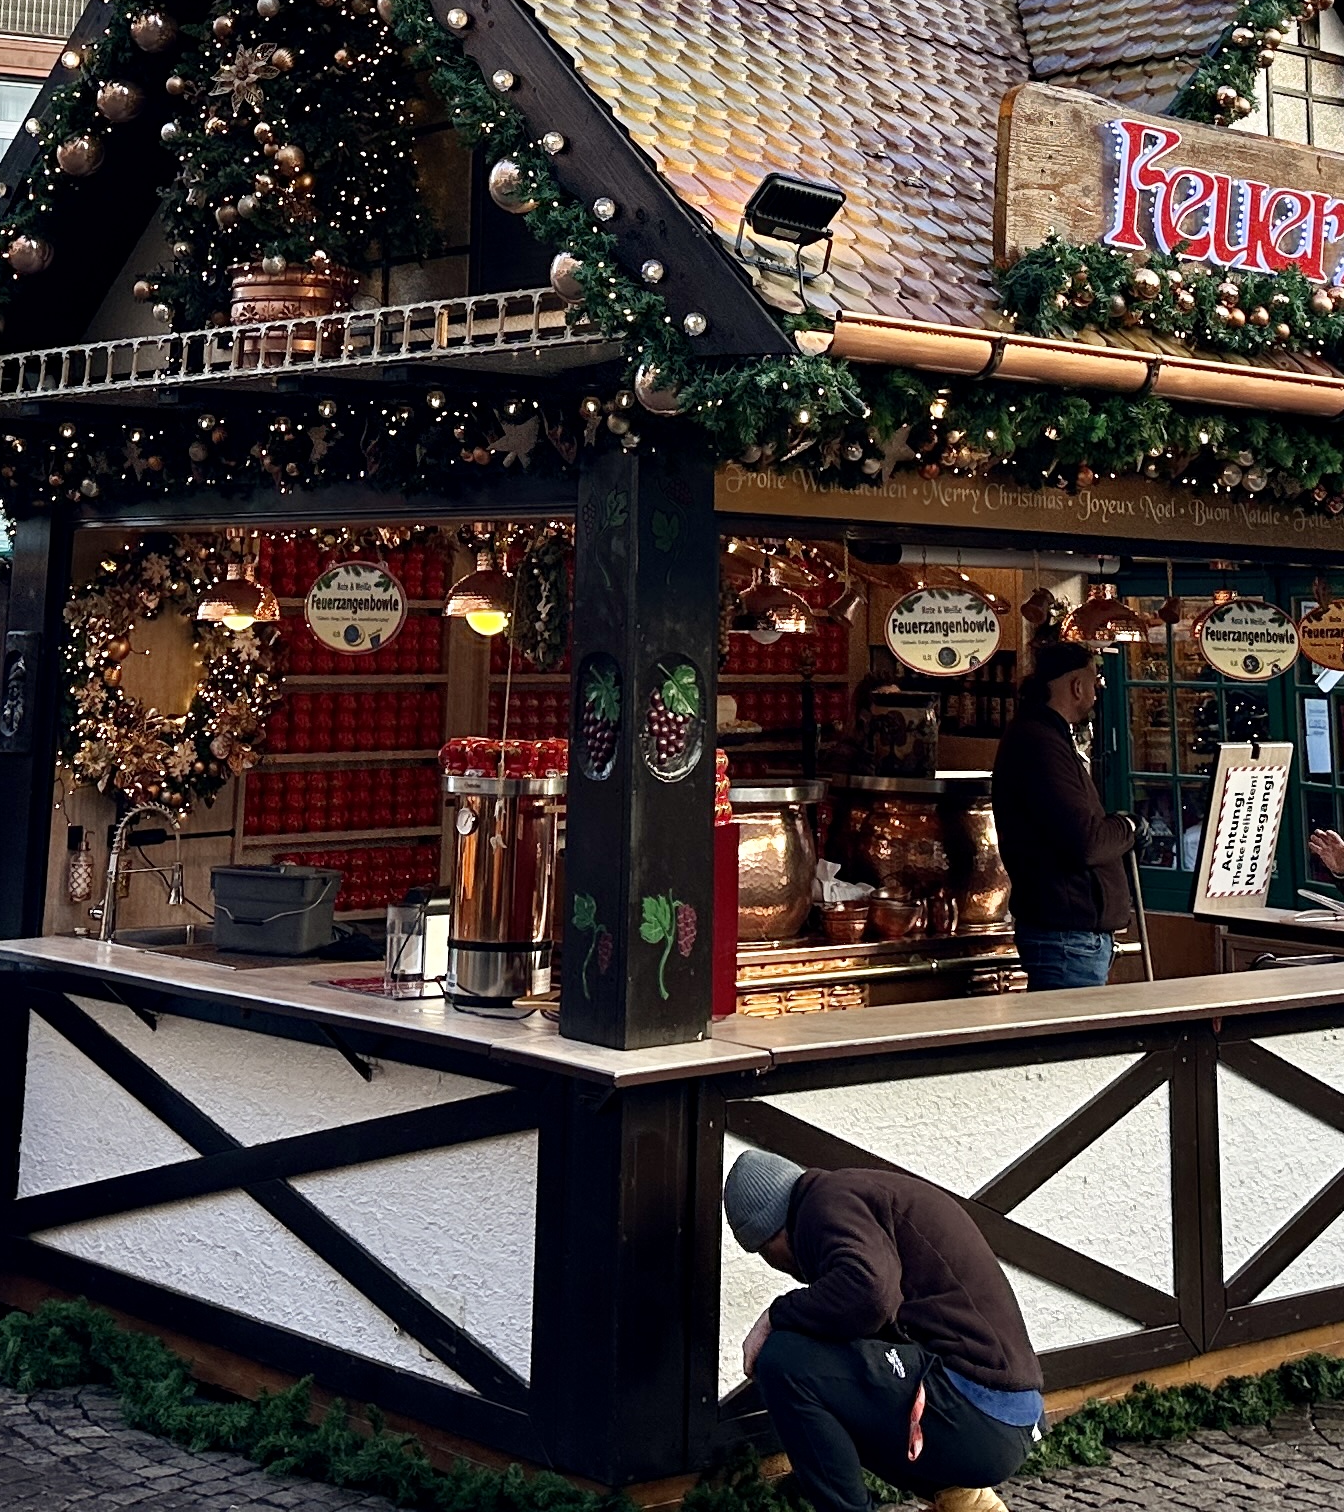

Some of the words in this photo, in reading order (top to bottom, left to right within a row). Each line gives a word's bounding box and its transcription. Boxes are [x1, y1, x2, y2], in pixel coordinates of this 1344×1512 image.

[725, 463, 786, 493] Frohe
[921, 479, 981, 515] Merry
[983, 482, 1063, 511] Christmas
[1077, 490, 1136, 523] Joyeux
[1139, 494, 1176, 525] Noel
[1188, 498, 1231, 527] Buon
[1234, 503, 1280, 530] Natale
[311, 594, 399, 614] Feuerzangenbowle
[891, 616, 996, 637] Feuerzangenbowle
[1205, 626, 1295, 647] Feuerzangenbowle
[1221, 792, 1245, 871] Achtung!
[1232, 846, 1246, 886] Theke
[1240, 775, 1259, 844] freihalten!
[1245, 775, 1275, 886] Notausgang!
